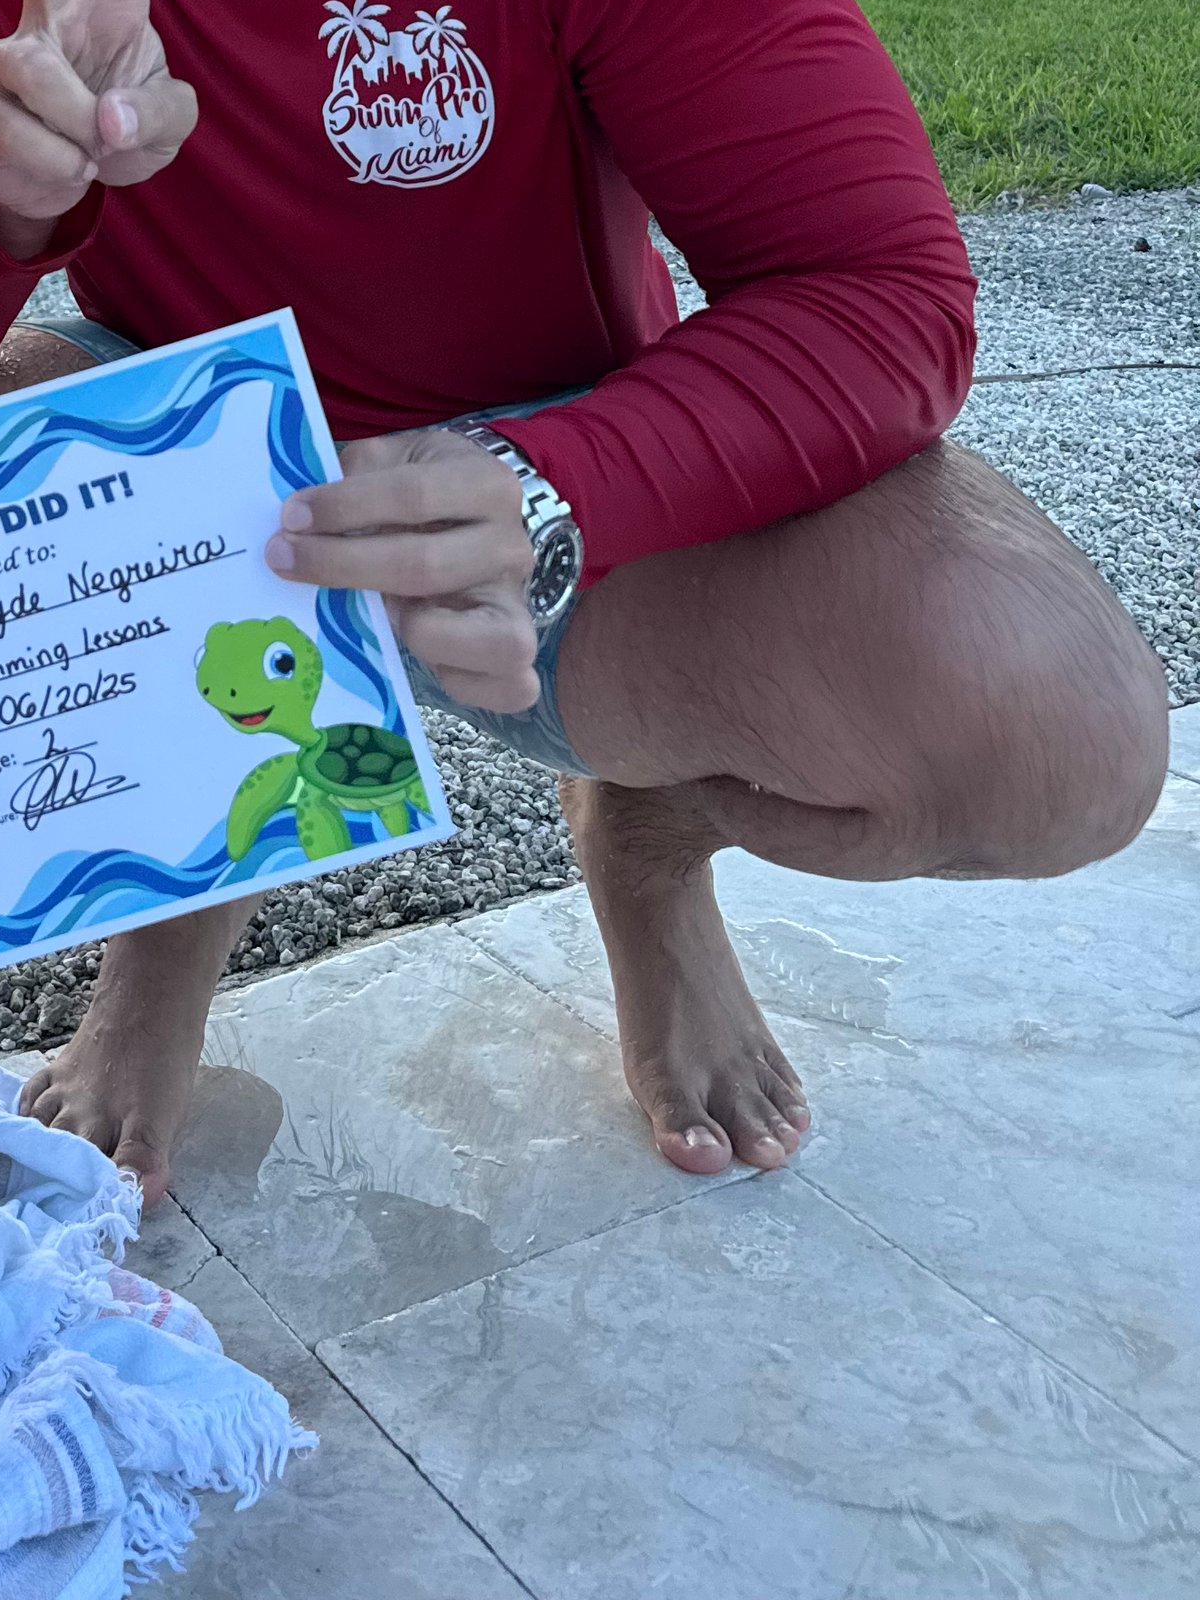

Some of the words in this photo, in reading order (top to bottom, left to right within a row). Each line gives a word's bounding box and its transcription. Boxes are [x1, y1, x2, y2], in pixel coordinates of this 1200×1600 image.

[329, 89, 421, 135] Swim
[426, 75, 487, 120] Pro
[418, 115, 442, 143] Of
[363, 133, 472, 175] Miami
[78, 470, 134, 509] IT!
[26, 543, 57, 566] to:
[68, 534, 226, 603] Negreira
[42, 727, 68, 760] 2
